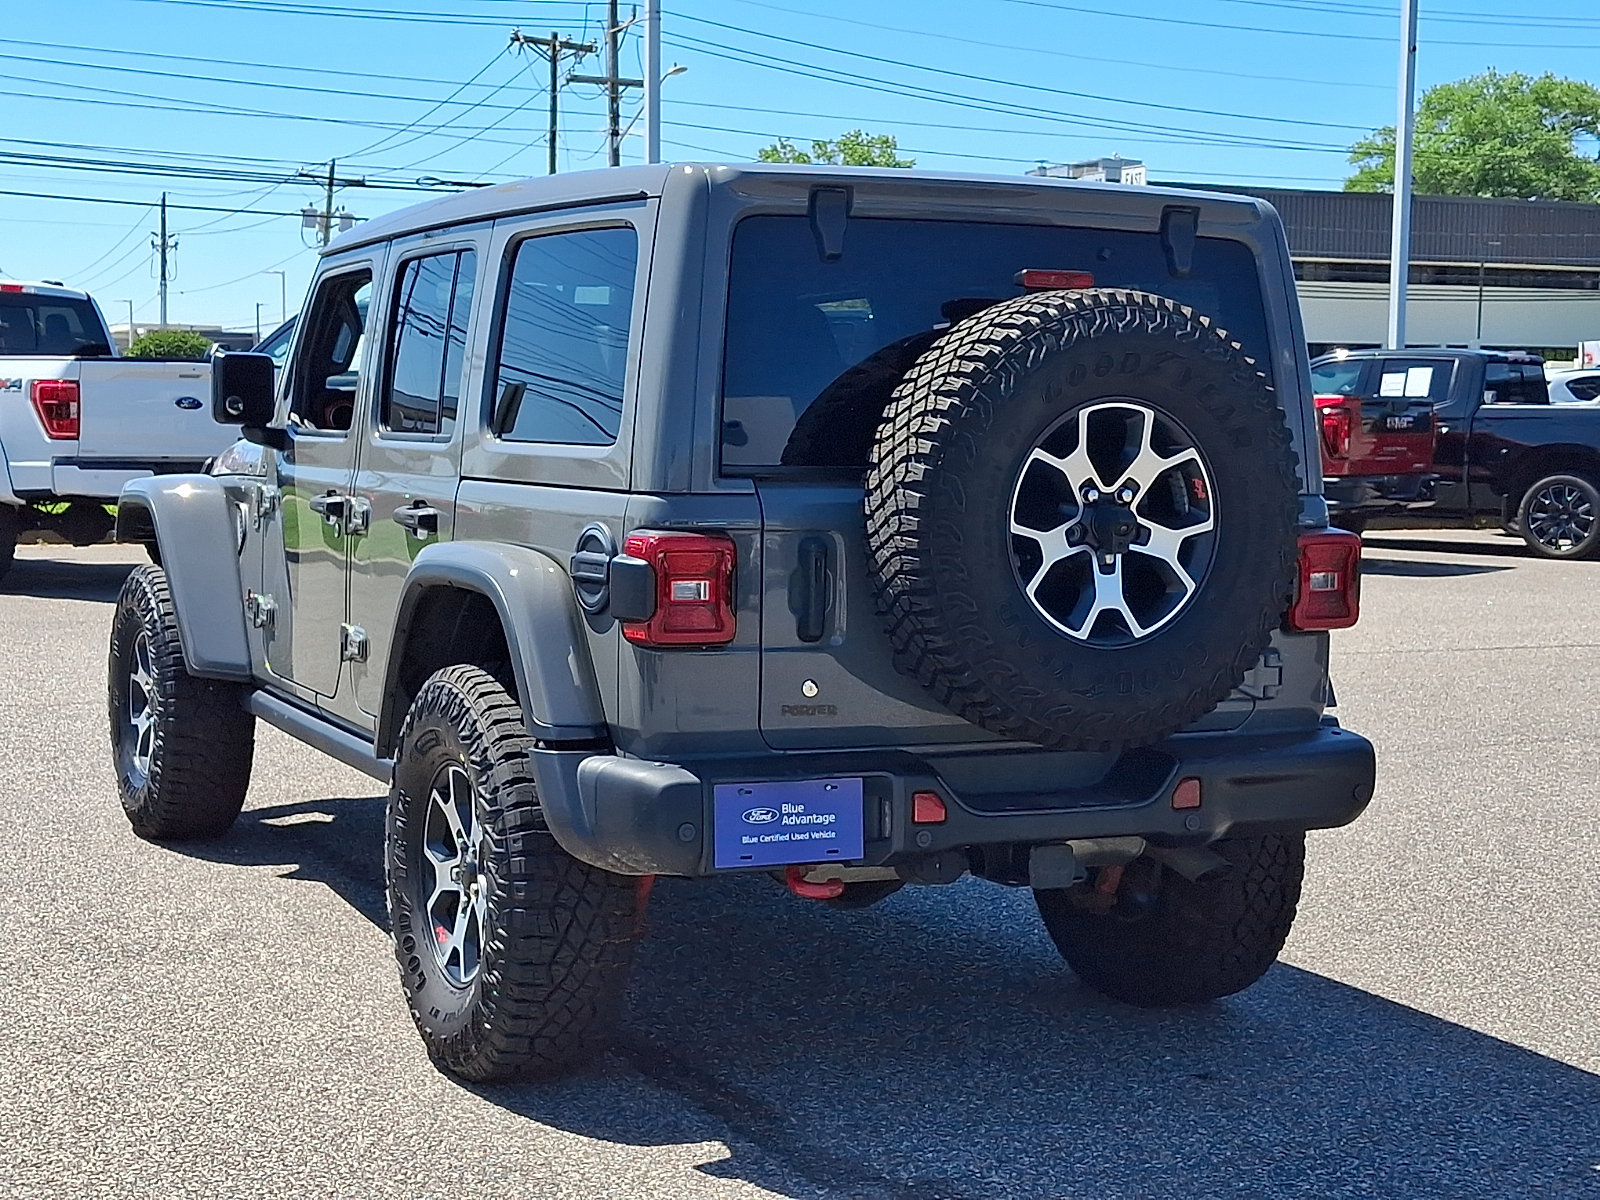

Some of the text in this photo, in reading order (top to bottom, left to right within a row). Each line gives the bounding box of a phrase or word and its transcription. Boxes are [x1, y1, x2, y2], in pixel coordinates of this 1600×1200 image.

[781, 803, 805, 814] Blue
[781, 813, 836, 826] Advantage
[741, 830, 836, 844] Blue Certified Used Vehicle
